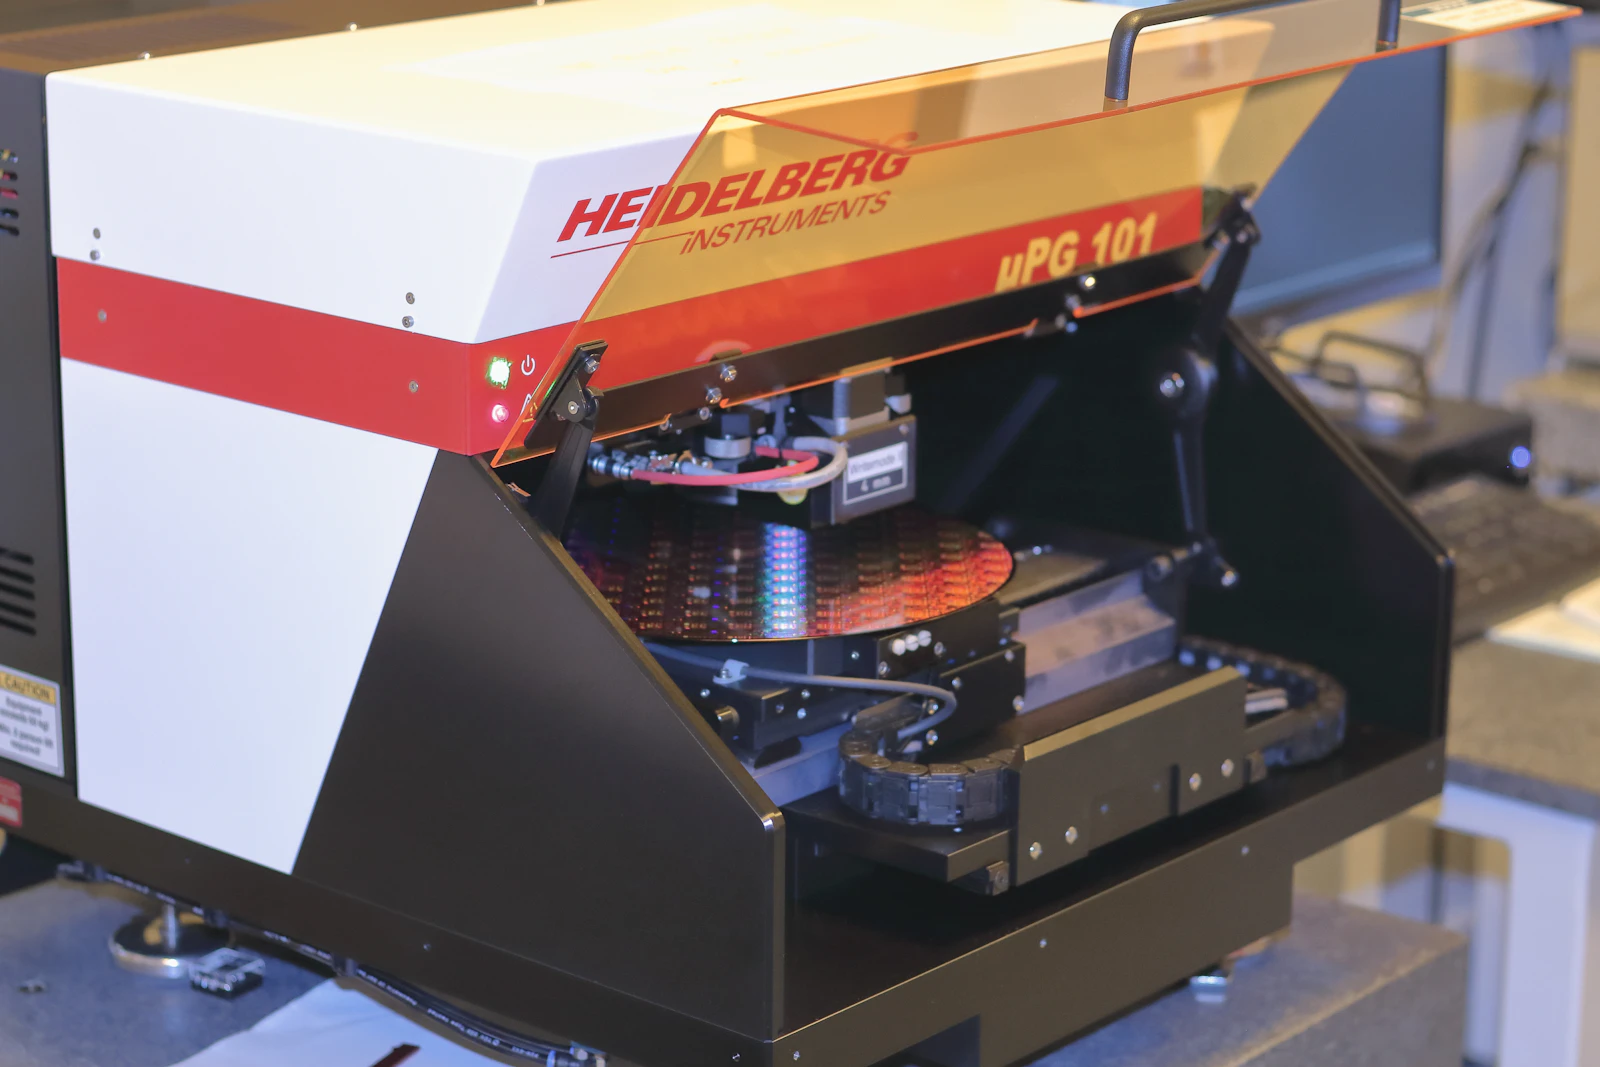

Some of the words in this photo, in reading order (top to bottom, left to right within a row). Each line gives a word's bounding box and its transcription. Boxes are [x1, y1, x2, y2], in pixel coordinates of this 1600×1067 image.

[556, 149, 910, 242] HEIDELBERG
[1091, 211, 1157, 268] 101
[5, 676, 50, 699] CAUTION
